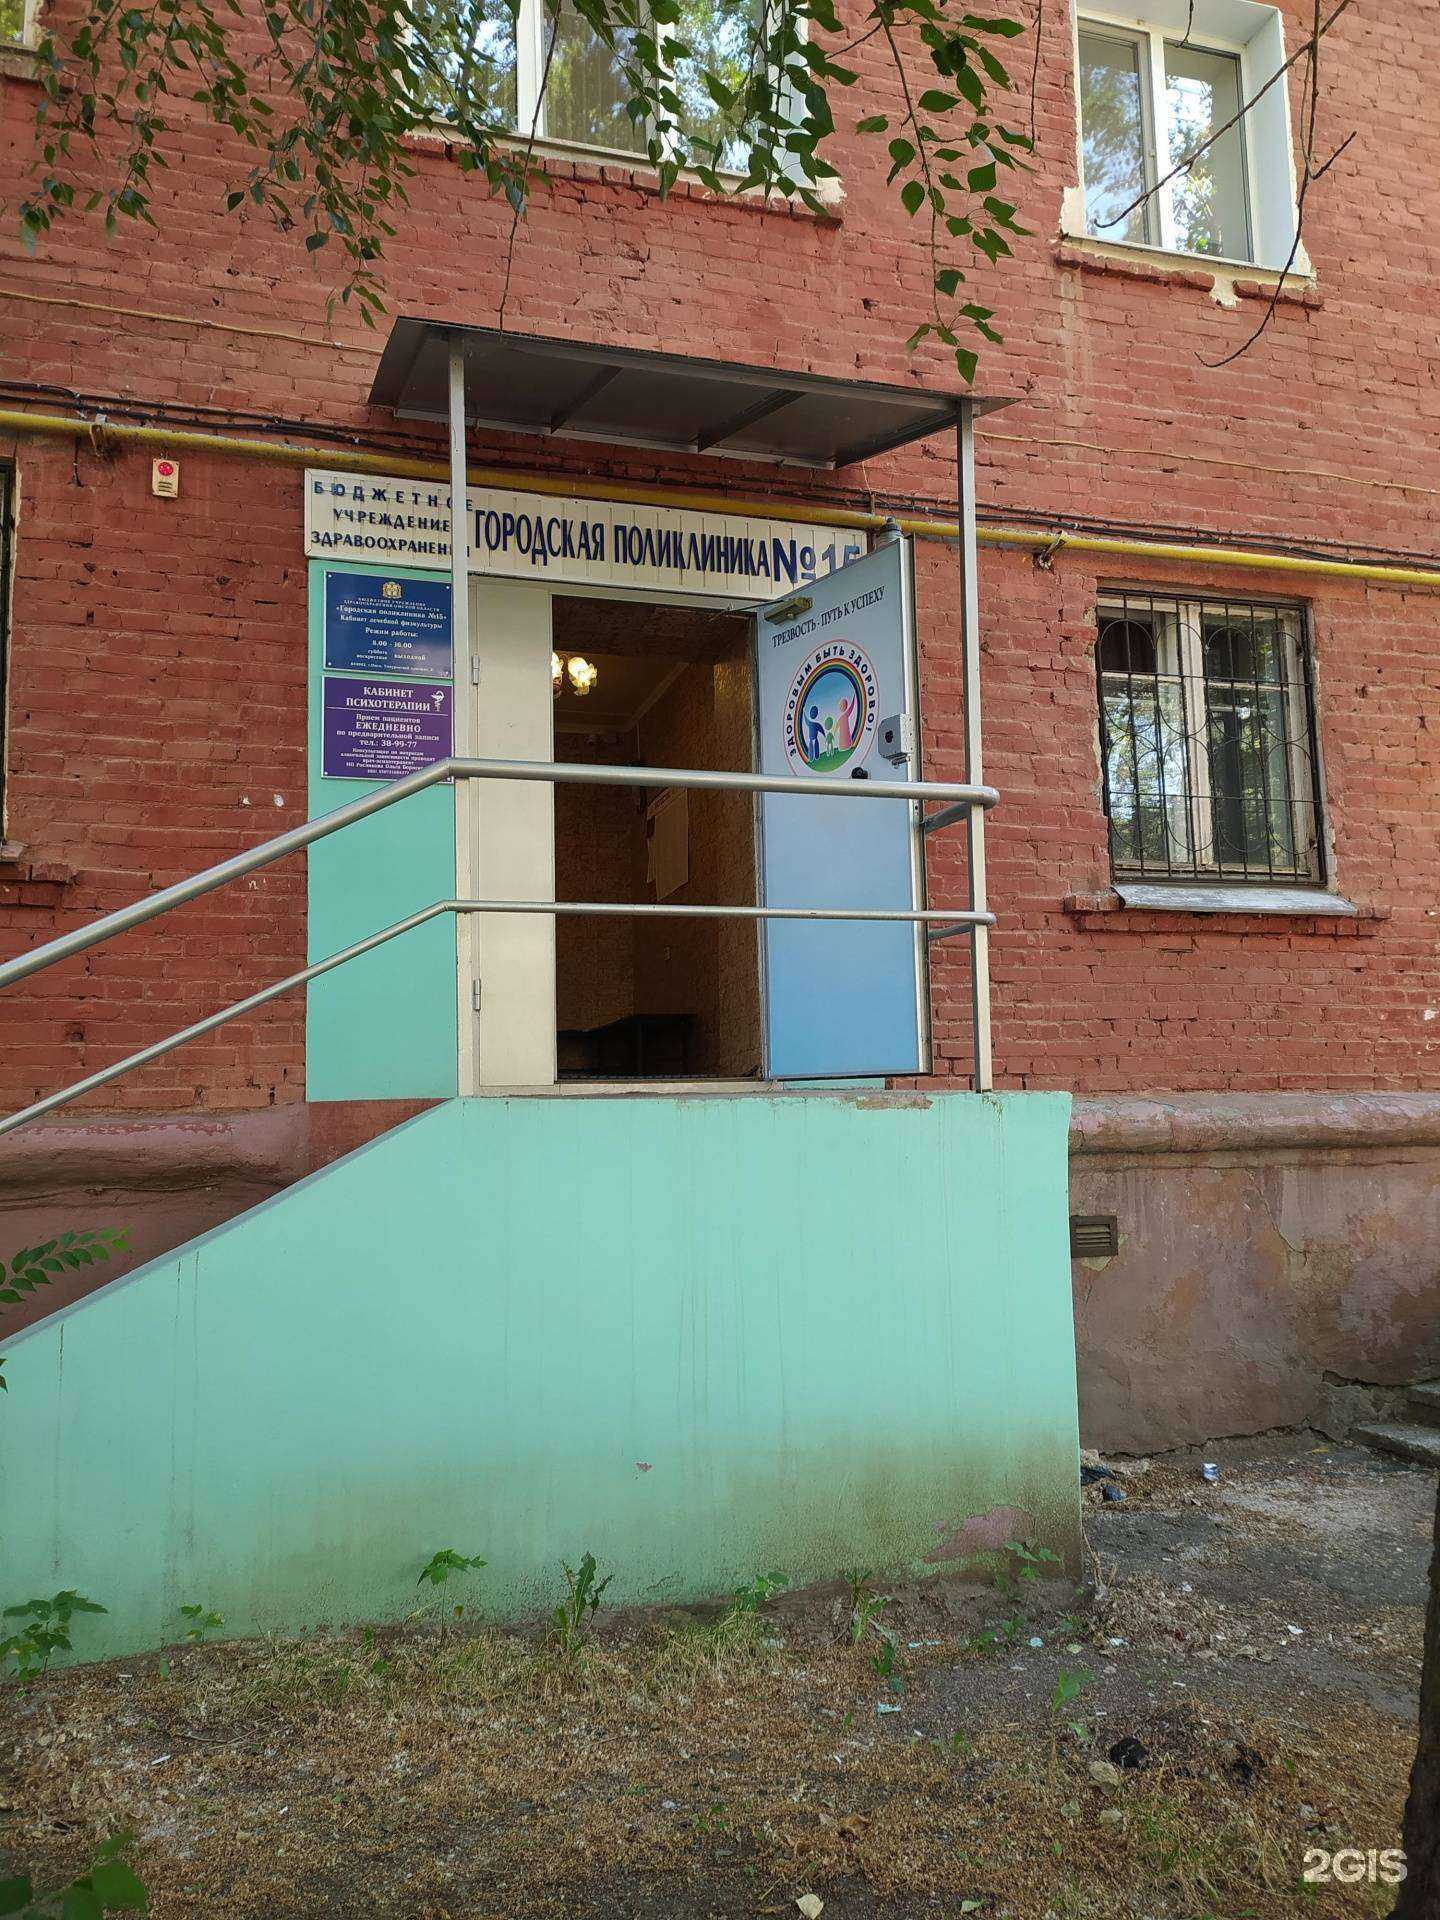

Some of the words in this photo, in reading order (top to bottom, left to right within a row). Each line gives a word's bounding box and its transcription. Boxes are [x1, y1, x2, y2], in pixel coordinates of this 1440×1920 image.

[333, 508, 450, 532] УЧРЕЖДЕНИЕ
[311, 530, 470, 558] ЗДРАВООХРАНЕН
[475, 509, 604, 566] ГОРОДСКАЯ
[614, 524, 771, 578] ПОЛИКЛИНИКА
[772, 618, 816, 648] ТРЕЗВОСТЬ
[821, 607, 843, 628] ПУТЬ
[844, 603, 852, 615] К
[851, 586, 886, 614] УСПЕХУ
[365, 627, 389, 635] Режим
[364, 686, 414, 698] КАБИНЕТ
[786, 662, 812, 757] ЗДОРОВЫМ
[816, 646, 846, 662] БЫТЬ
[346, 698, 430, 711] ПСИХОТЕРАПИИ
[356, 722, 421, 732] ЕЖЕДНЕВНО
